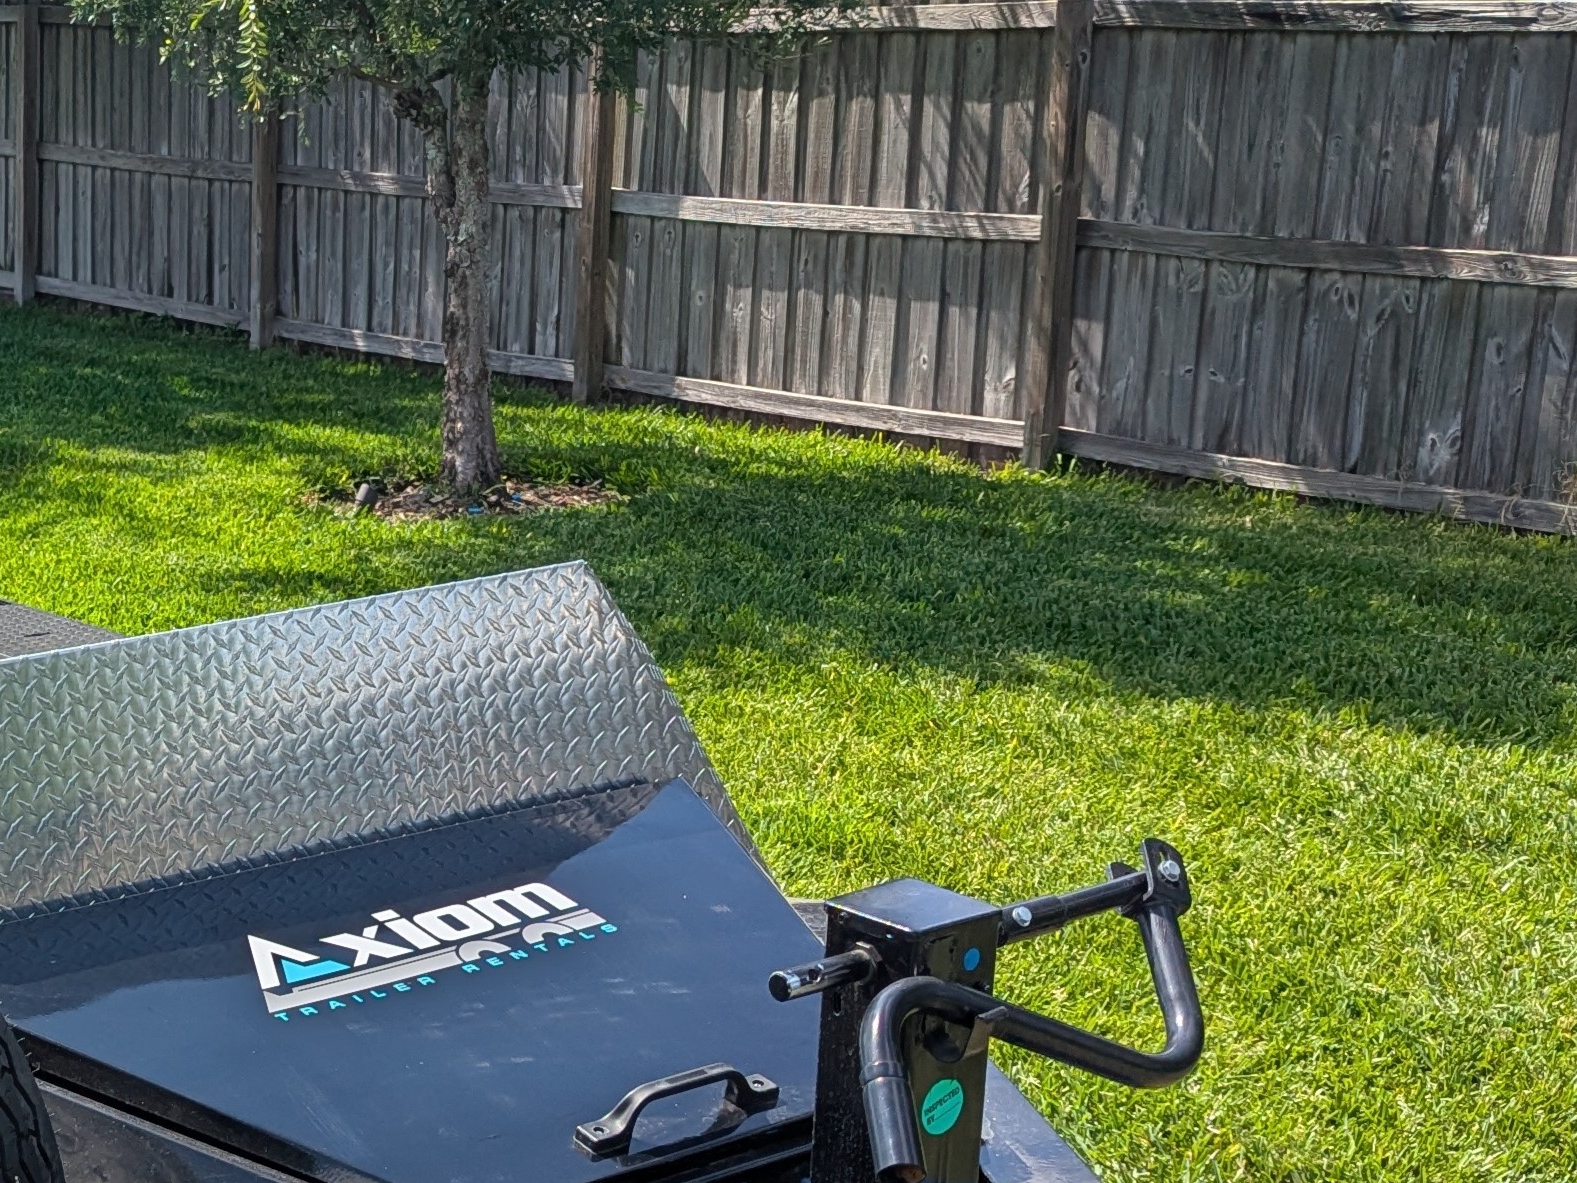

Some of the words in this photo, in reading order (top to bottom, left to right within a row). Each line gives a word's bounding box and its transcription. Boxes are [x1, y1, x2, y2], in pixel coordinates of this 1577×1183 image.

[247, 882, 579, 991] Axiom
[273, 976, 436, 1023] TRAILER
[461, 923, 619, 974] RENTALS
[925, 1087, 960, 1114] INSPECTED
[927, 1114, 935, 1126] BY
